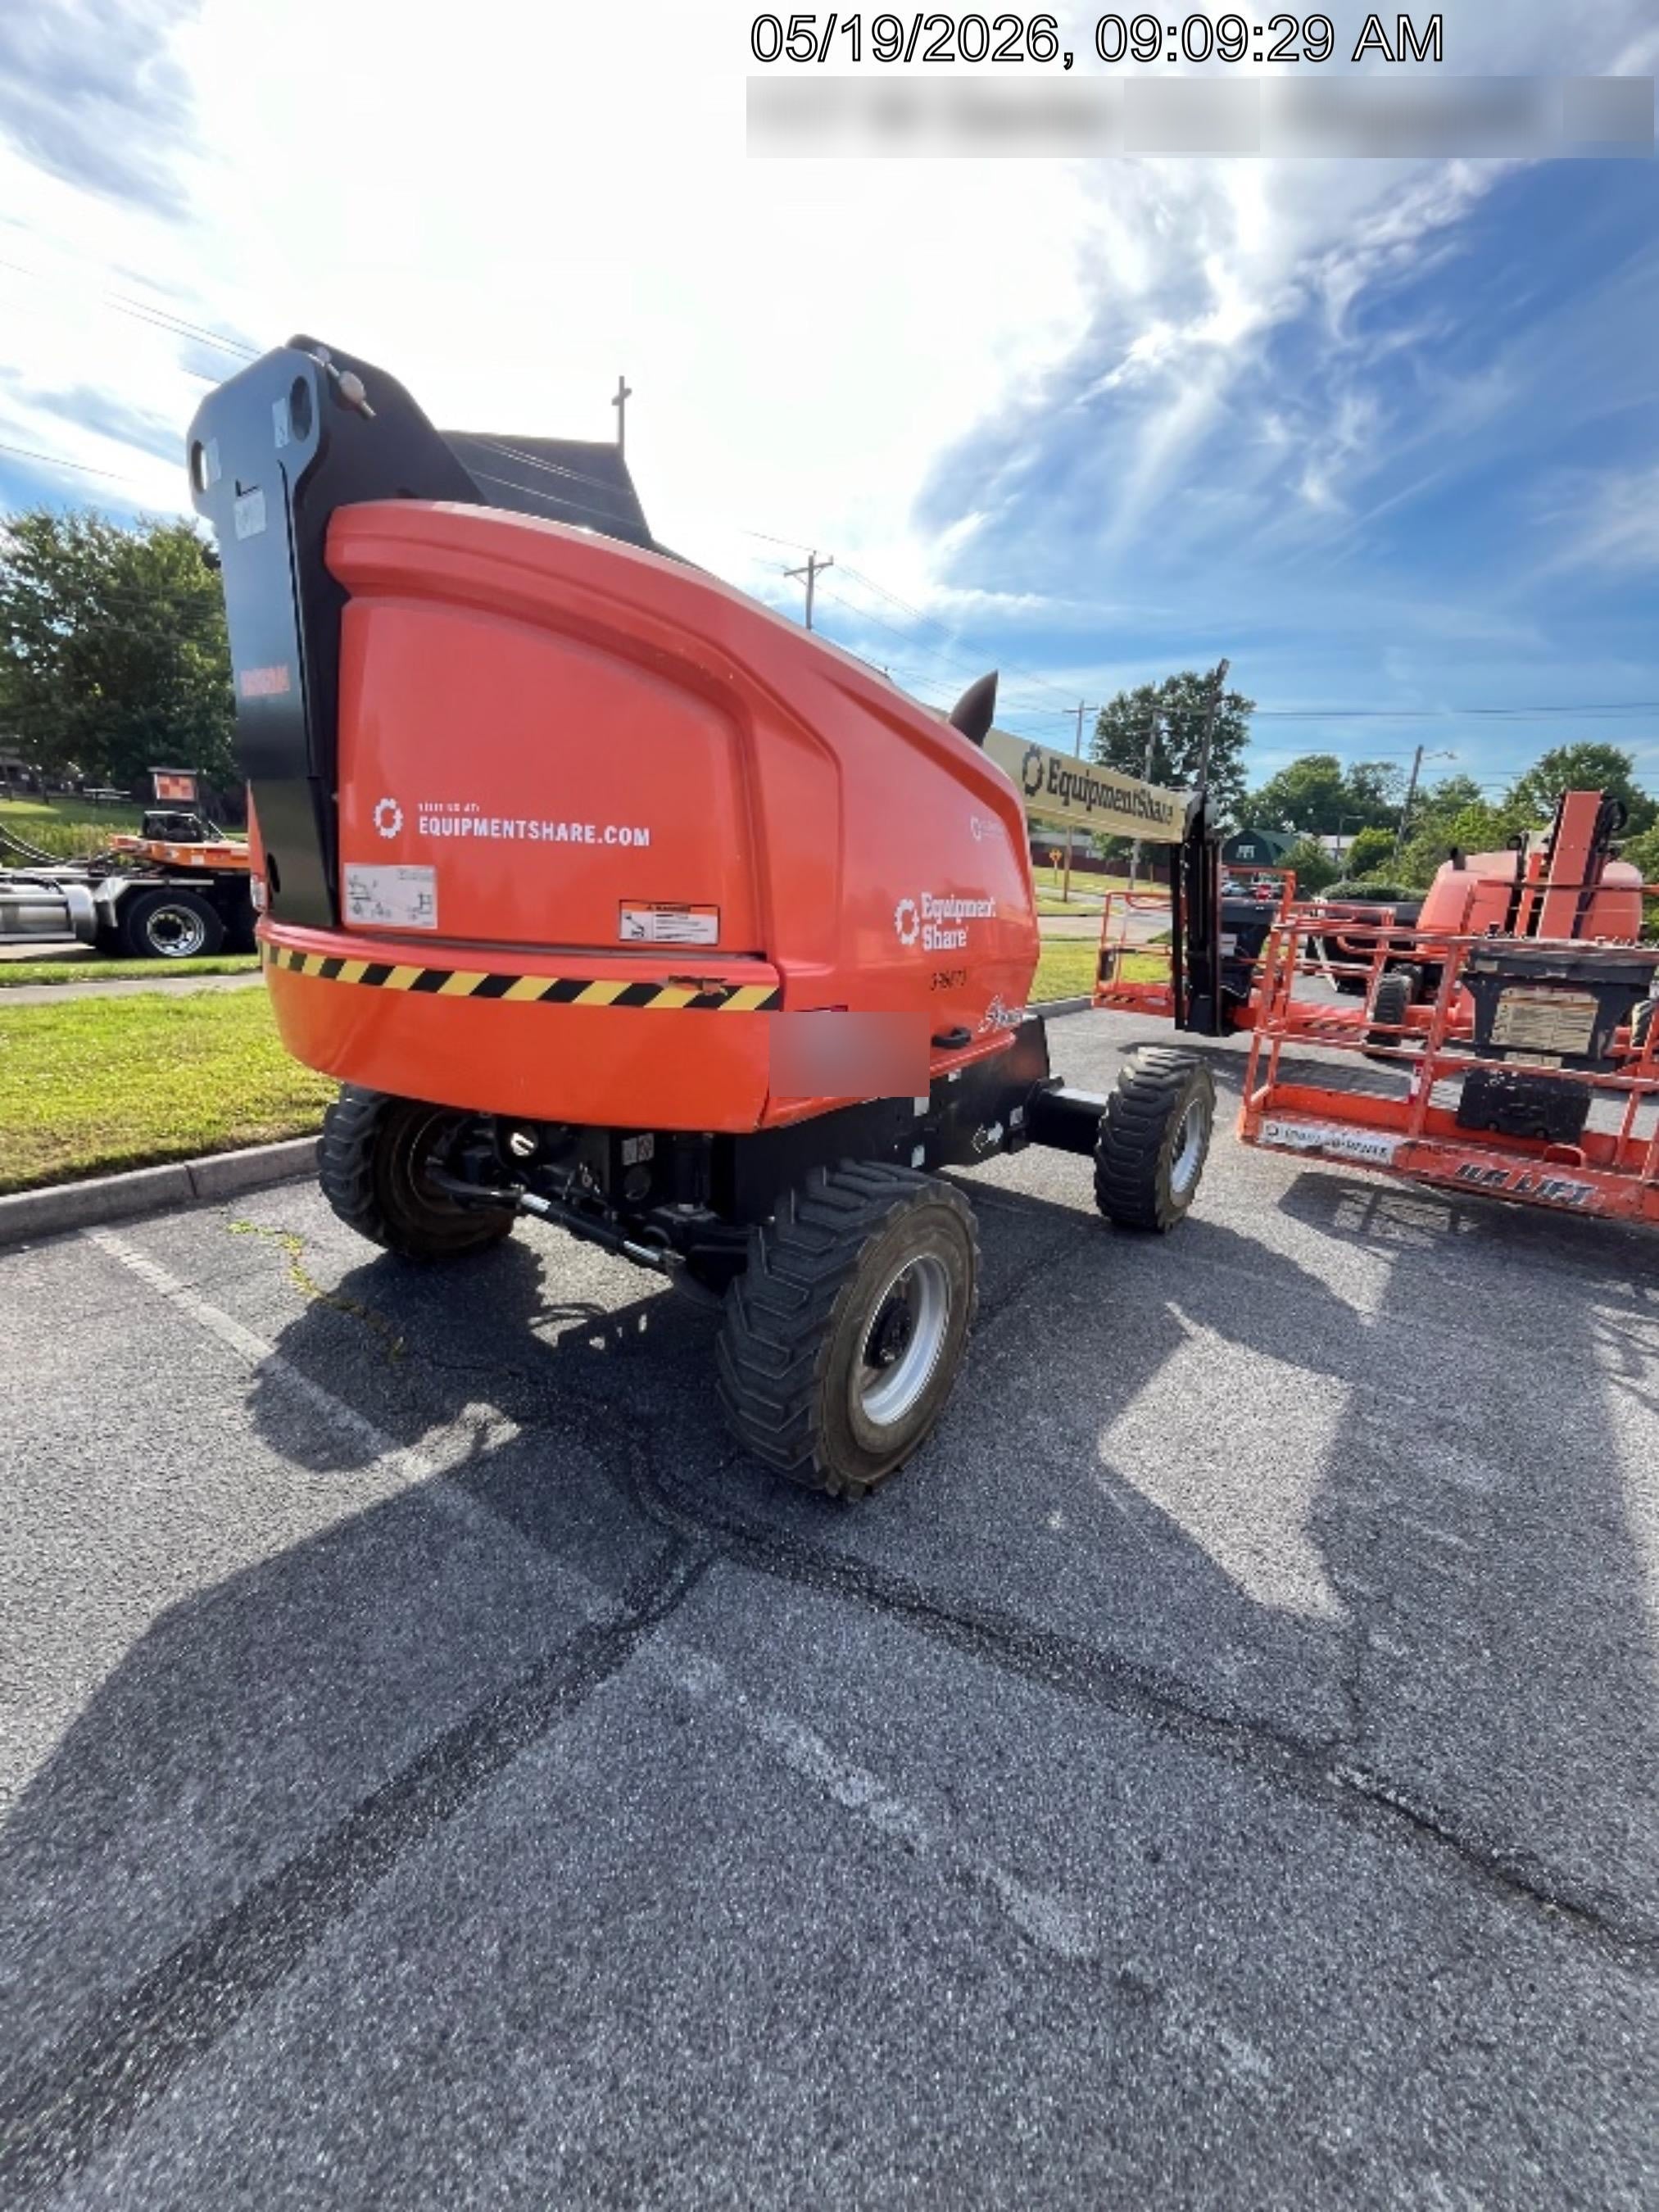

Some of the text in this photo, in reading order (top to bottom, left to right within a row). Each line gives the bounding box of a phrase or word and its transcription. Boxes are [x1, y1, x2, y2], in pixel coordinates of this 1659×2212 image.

[419, 816, 650, 846] EQUIPMENTSHARE.COM
[921, 891, 996, 925] Equipment
[922, 923, 968, 951] Share
